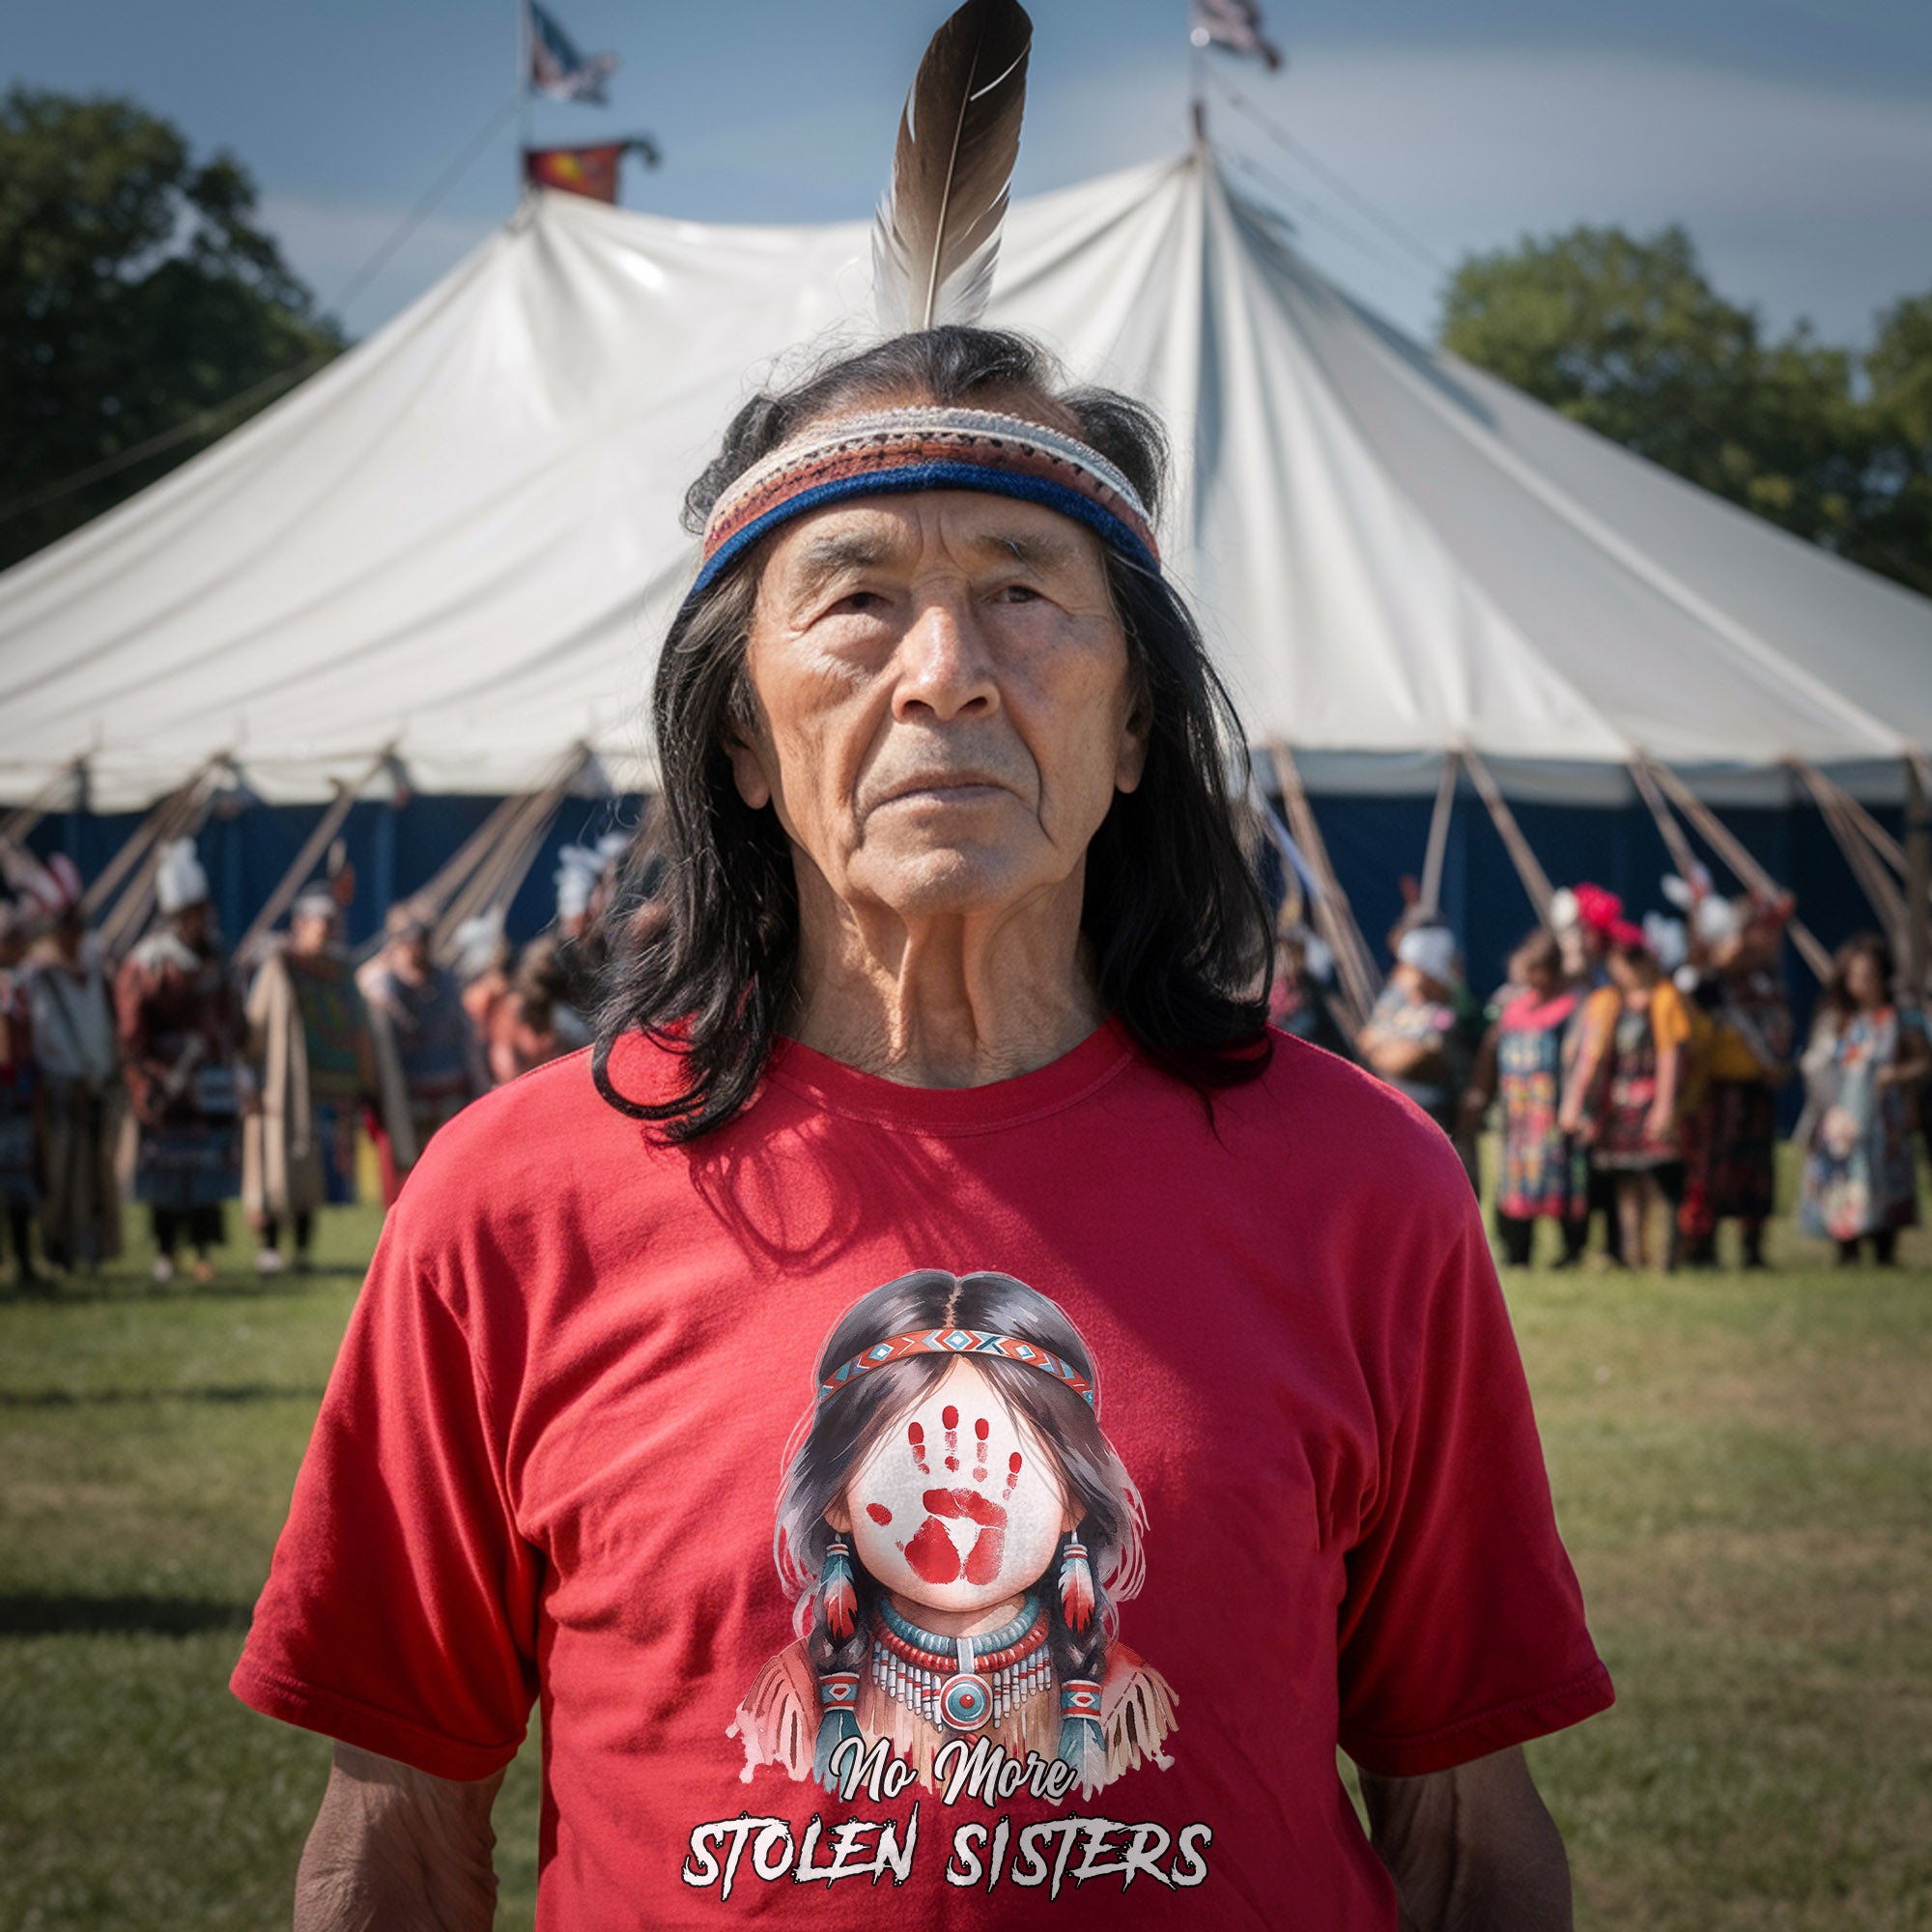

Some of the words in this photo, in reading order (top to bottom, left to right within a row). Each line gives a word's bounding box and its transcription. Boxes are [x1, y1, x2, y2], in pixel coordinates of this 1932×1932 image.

[830, 1735, 918, 1803] No
[933, 1735, 1078, 1807] More
[682, 1802, 920, 1901] STOLEN
[946, 1811, 1213, 1901] SISTERS
